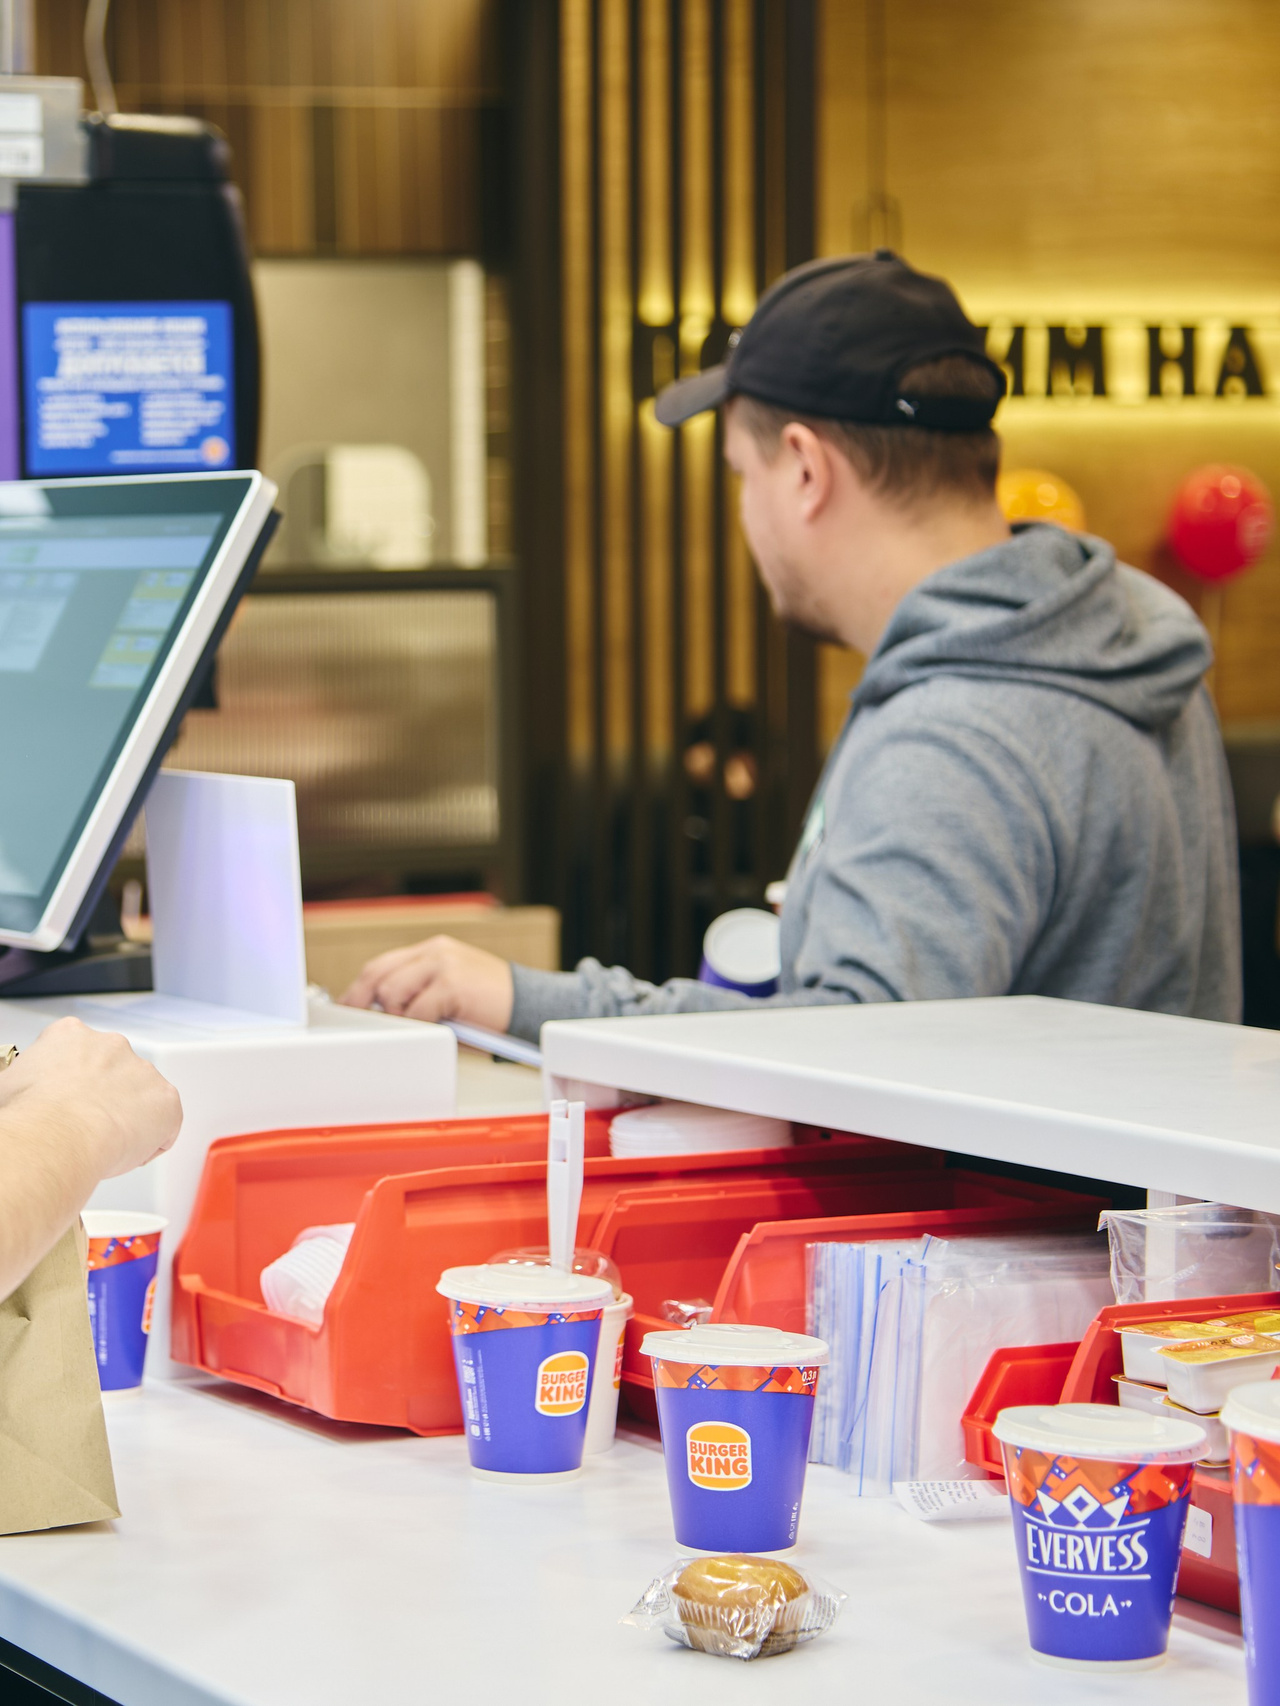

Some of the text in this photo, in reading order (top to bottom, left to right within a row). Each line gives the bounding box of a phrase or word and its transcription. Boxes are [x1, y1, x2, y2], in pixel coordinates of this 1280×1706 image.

[1147, 326, 1268, 398] НА
[541, 1370, 586, 1385] BURGER
[540, 1383, 585, 1402] KING
[690, 1441, 748, 1457] BURGER
[690, 1454, 749, 1476] KING
[1026, 1522, 1149, 1572] EVERVESS
